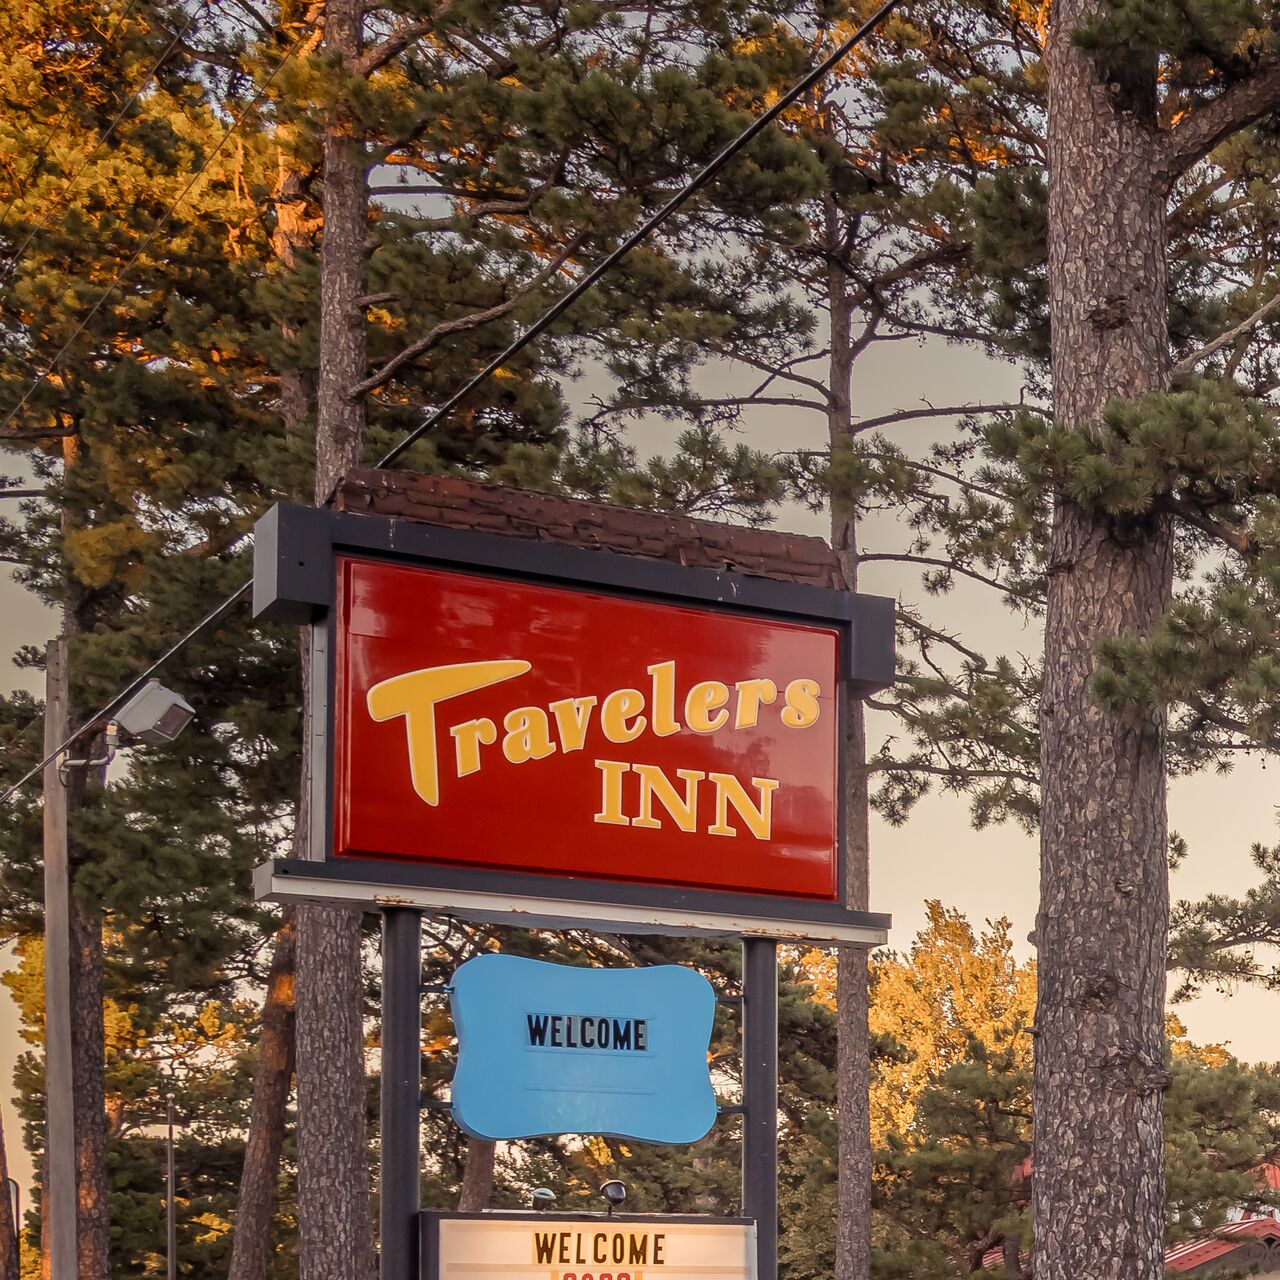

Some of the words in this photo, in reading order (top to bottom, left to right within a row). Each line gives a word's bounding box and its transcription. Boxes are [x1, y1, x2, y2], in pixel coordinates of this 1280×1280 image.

[366, 659, 822, 807] Travelers
[593, 759, 780, 841] INN
[527, 1014, 647, 1051] WELCOME
[535, 1232, 666, 1264] WELCOME
